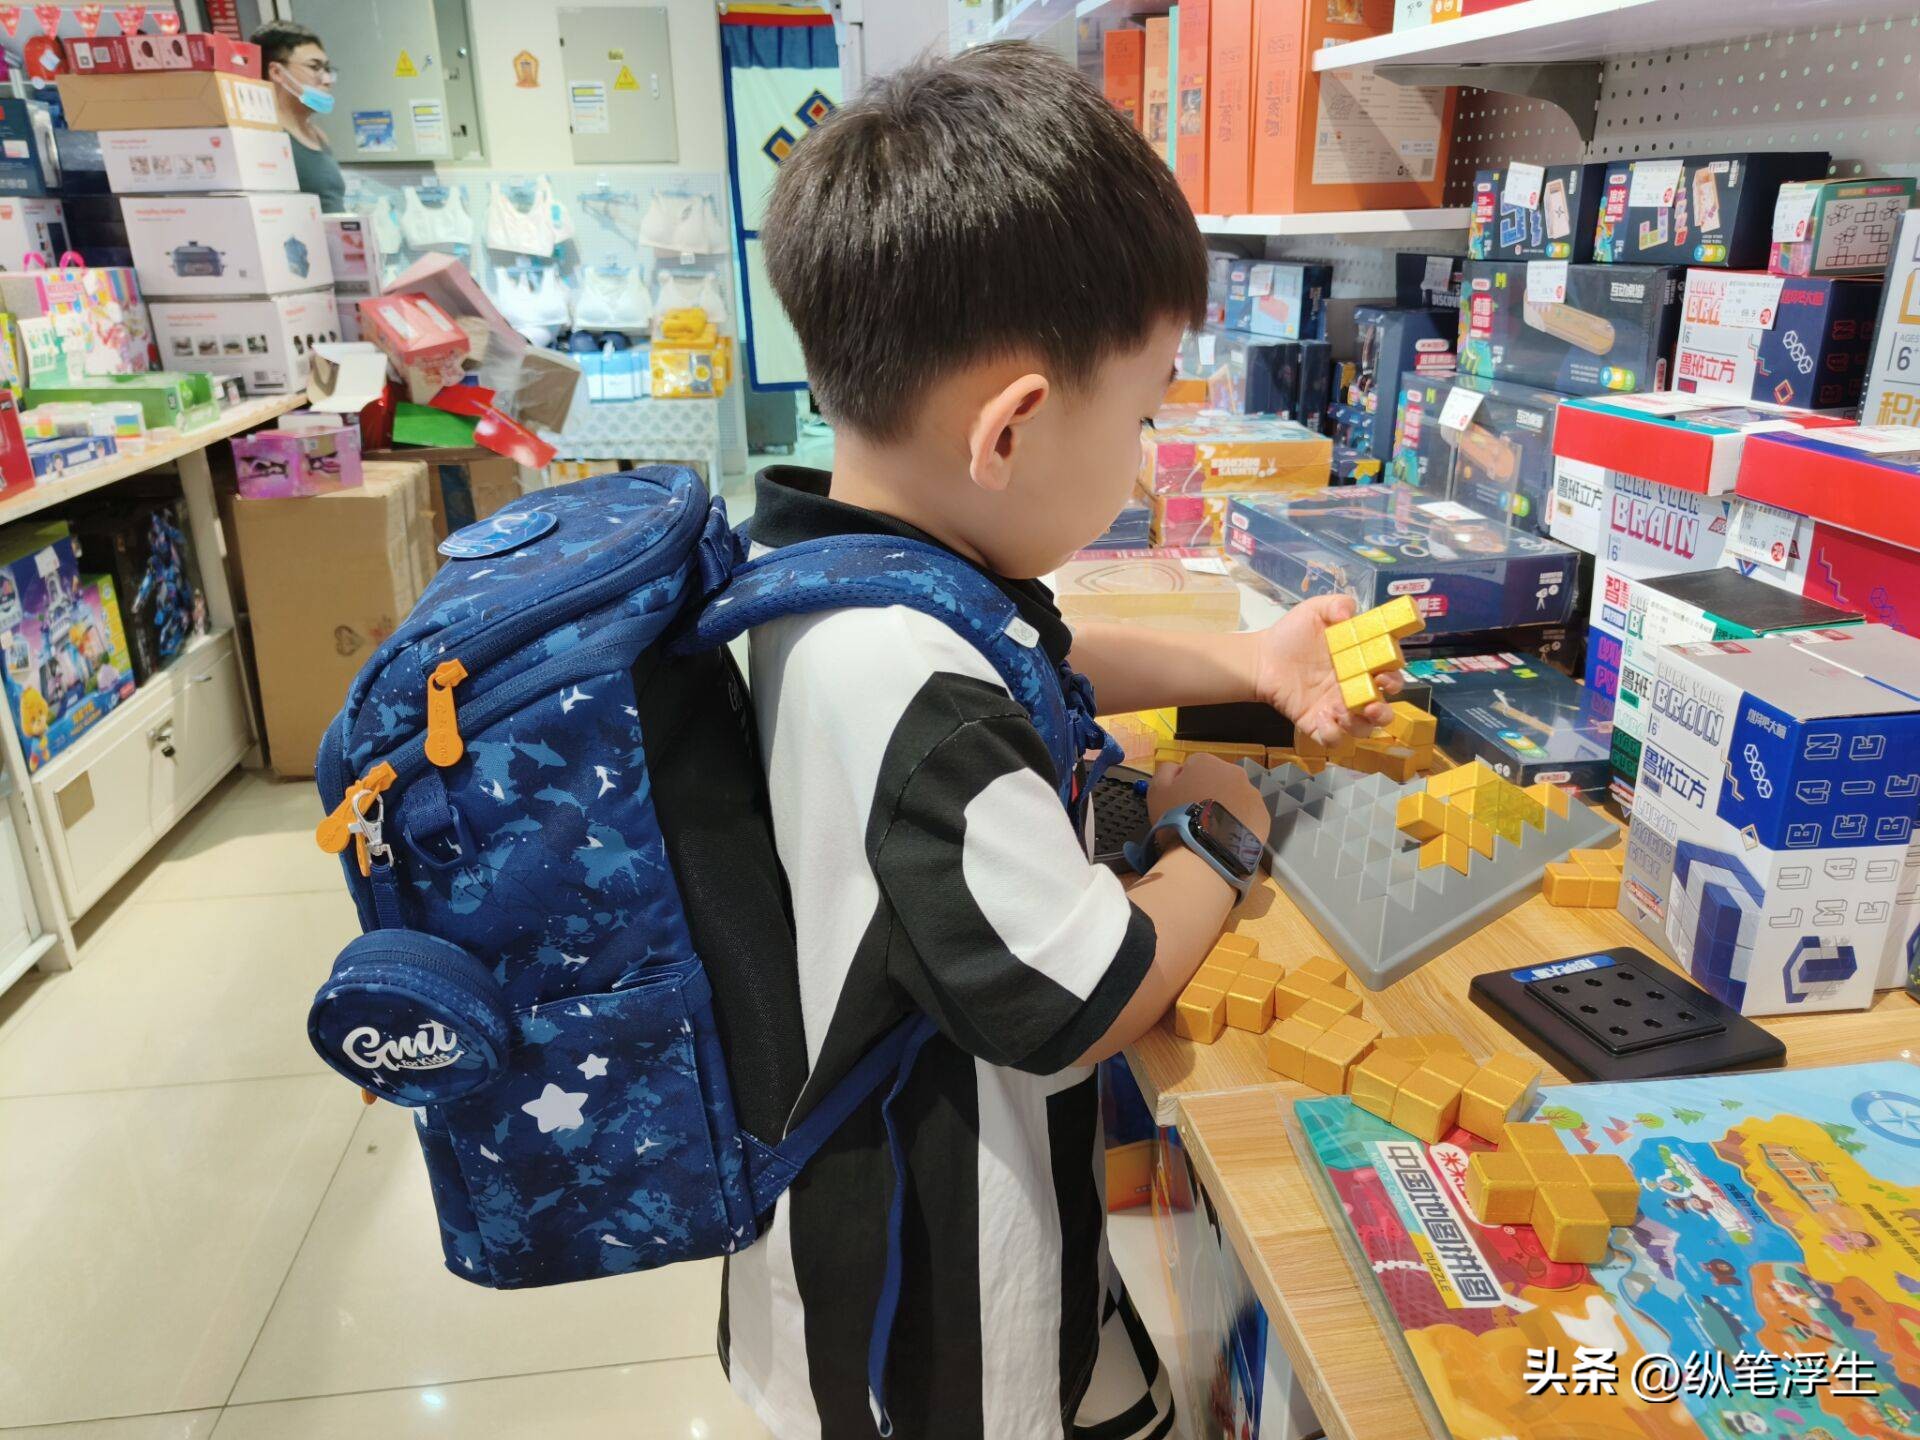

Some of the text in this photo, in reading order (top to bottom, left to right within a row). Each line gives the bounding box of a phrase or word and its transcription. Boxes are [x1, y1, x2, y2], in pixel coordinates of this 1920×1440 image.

[1686, 295, 1720, 325] BRA
[1679, 351, 1736, 384] 鲁班立方
[1876, 391, 1920, 425] 积
[1611, 492, 1699, 560] BRAIN
[1620, 666, 1653, 701] 鲁班
[1652, 680, 1724, 747] BRAIN
[1642, 745, 1707, 809] 鲁班立方
[1387, 1145, 1502, 1302] 中国地图拼图
[1423, 1251, 1453, 1293] PUZZLE
